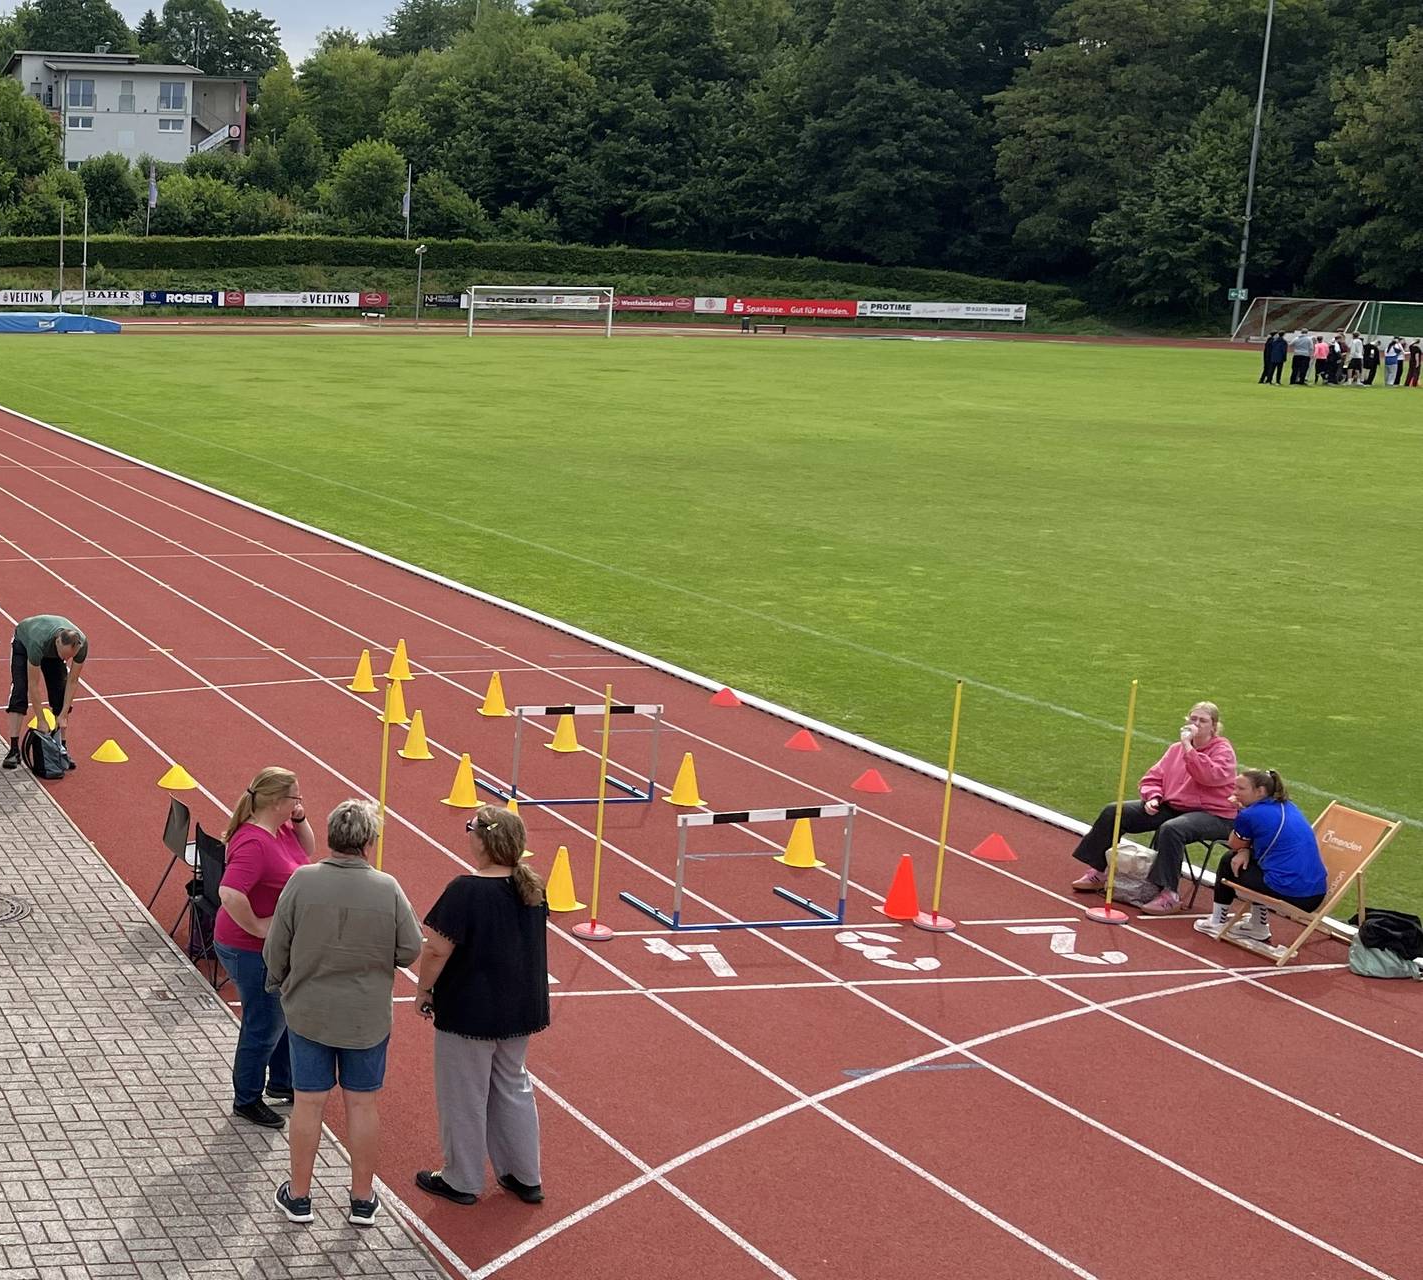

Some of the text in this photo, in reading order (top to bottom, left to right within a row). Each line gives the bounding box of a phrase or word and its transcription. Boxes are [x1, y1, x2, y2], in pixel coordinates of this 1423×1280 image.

[9, 292, 44, 303] VELTINS
[87, 291, 130, 299] BAHR
[165, 293, 213, 304] ROSIER
[309, 294, 350, 304] VELTINS
[746, 305, 849, 315] Sparkasse. Gut für Menden.
[870, 303, 912, 311] PROTIME
[642, 925, 1129, 977] 4 3 2
